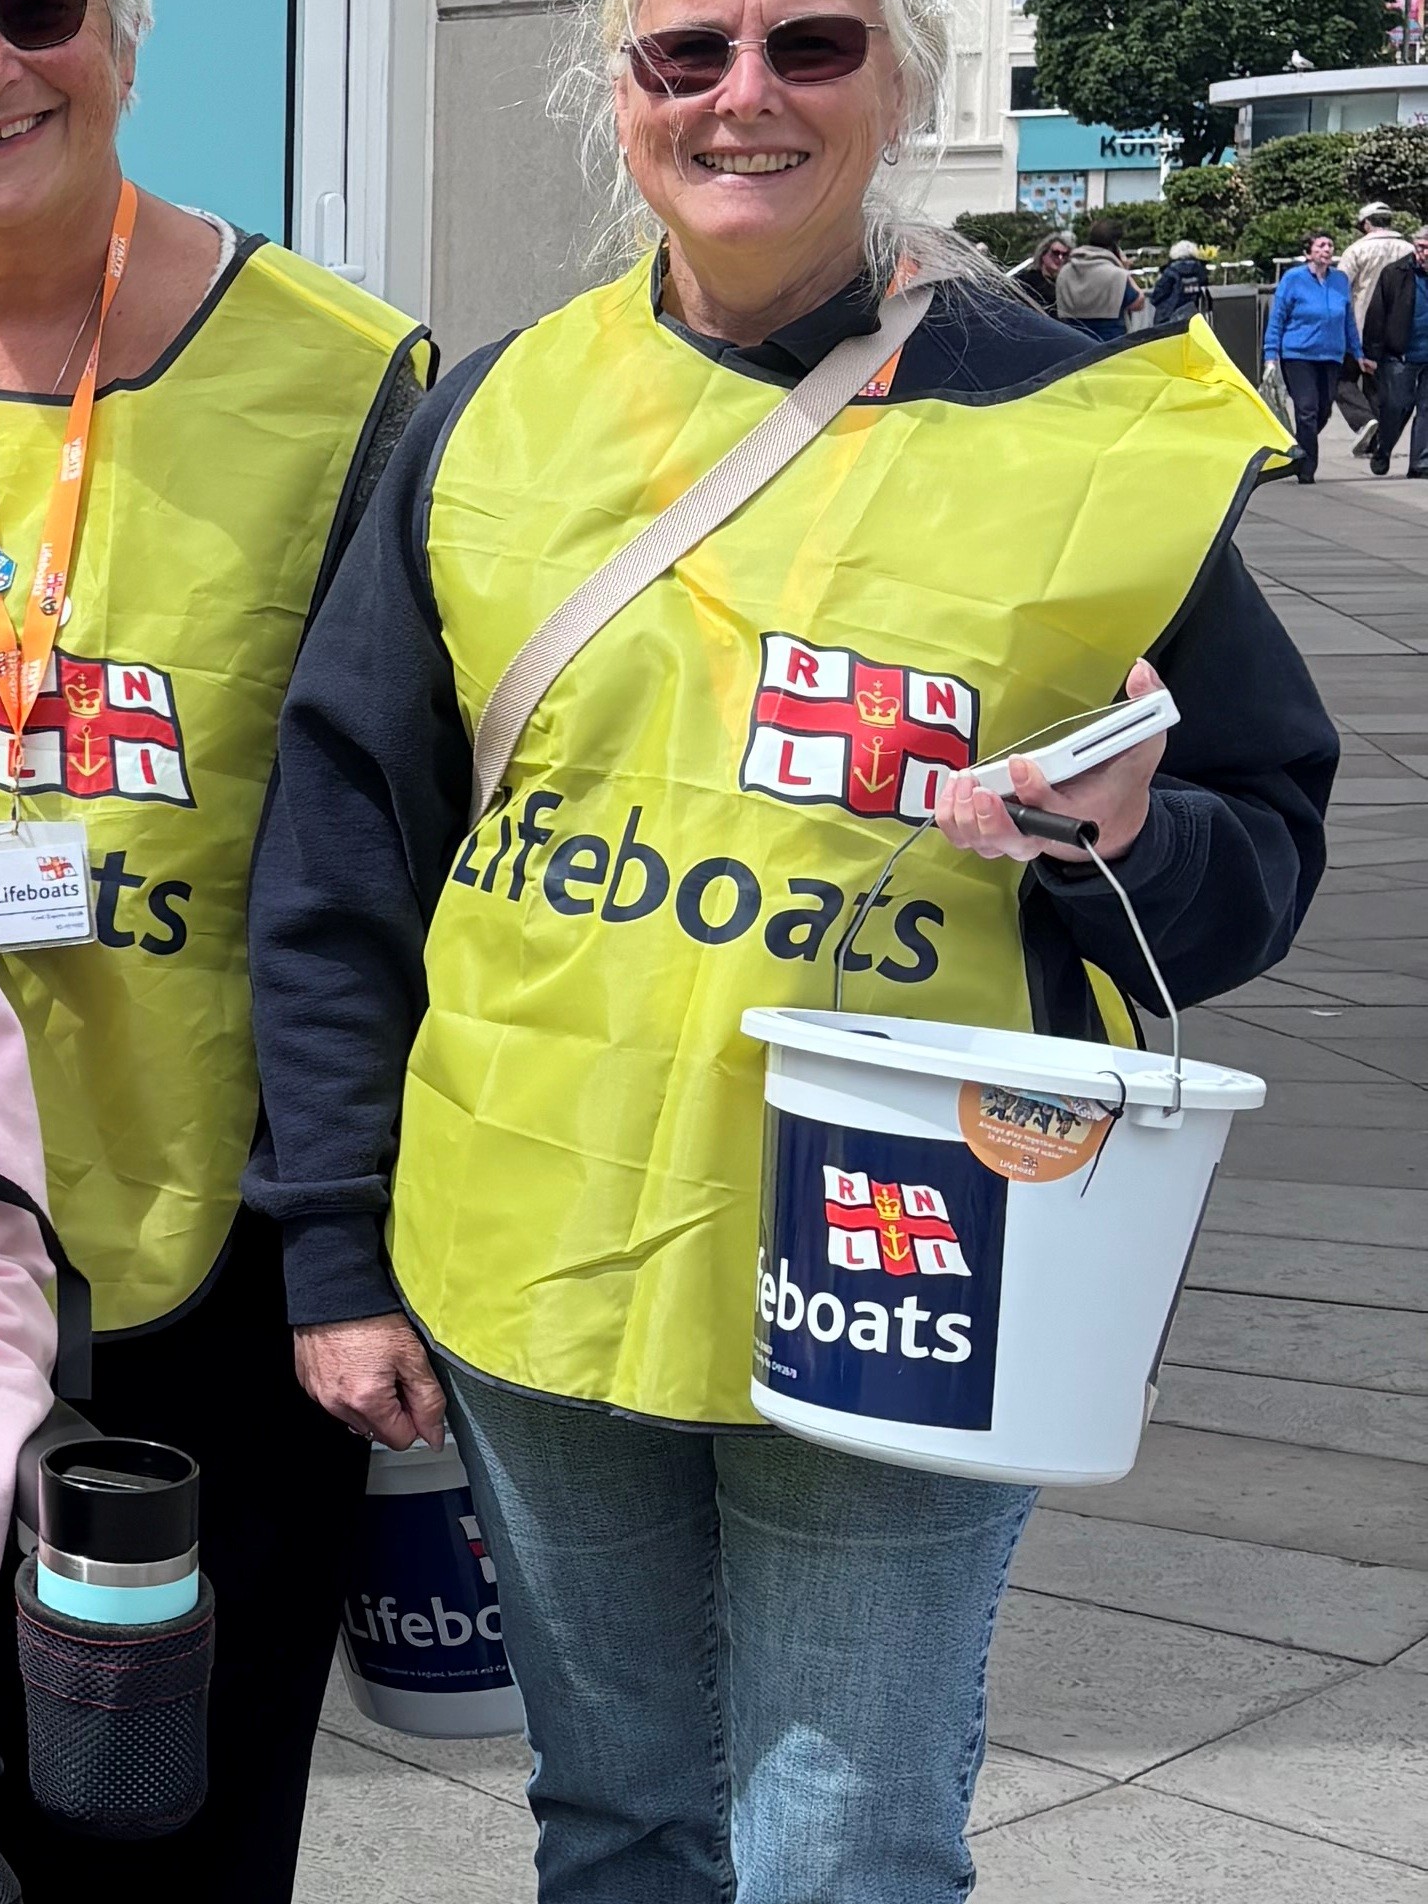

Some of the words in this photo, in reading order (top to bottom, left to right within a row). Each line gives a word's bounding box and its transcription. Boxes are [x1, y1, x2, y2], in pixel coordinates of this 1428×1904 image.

[787, 645, 819, 688] R
[926, 681, 957, 720] N
[778, 739, 812, 788] L
[453, 787, 946, 984] Lifeboats
[999, 1159, 1036, 1177] Lifeboats
